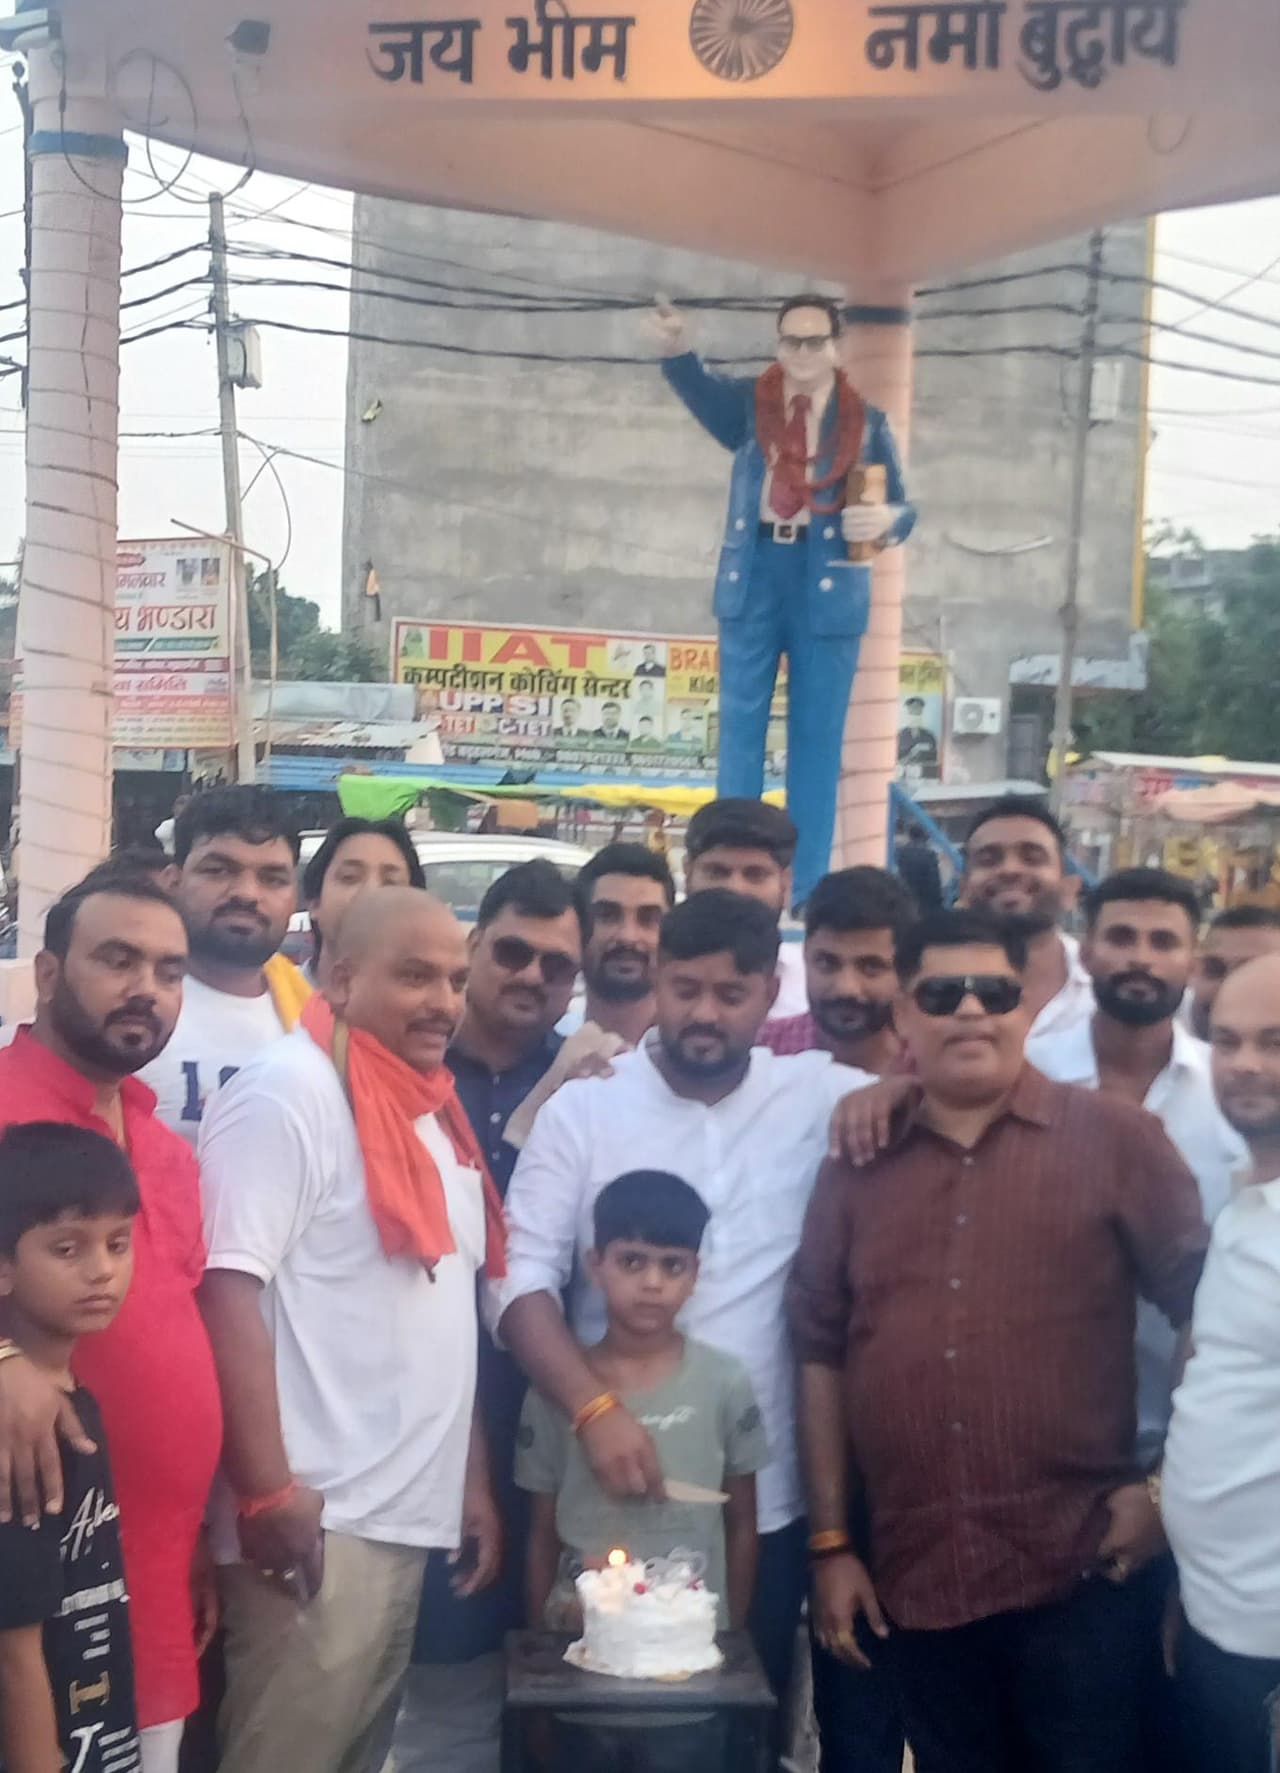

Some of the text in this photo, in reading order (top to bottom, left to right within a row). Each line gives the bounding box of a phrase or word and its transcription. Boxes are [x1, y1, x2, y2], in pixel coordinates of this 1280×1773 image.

[366, 18, 481, 84] जय
[505, 0, 636, 82] भीम
[137, 603, 218, 632] भण्डारा
[428, 625, 608, 669] IIAT
[670, 643, 718, 672] BRA
[510, 667, 577, 696] कोचिंग
[582, 671, 634, 699] सेन्टर
[439, 688, 553, 717] UPP SI
